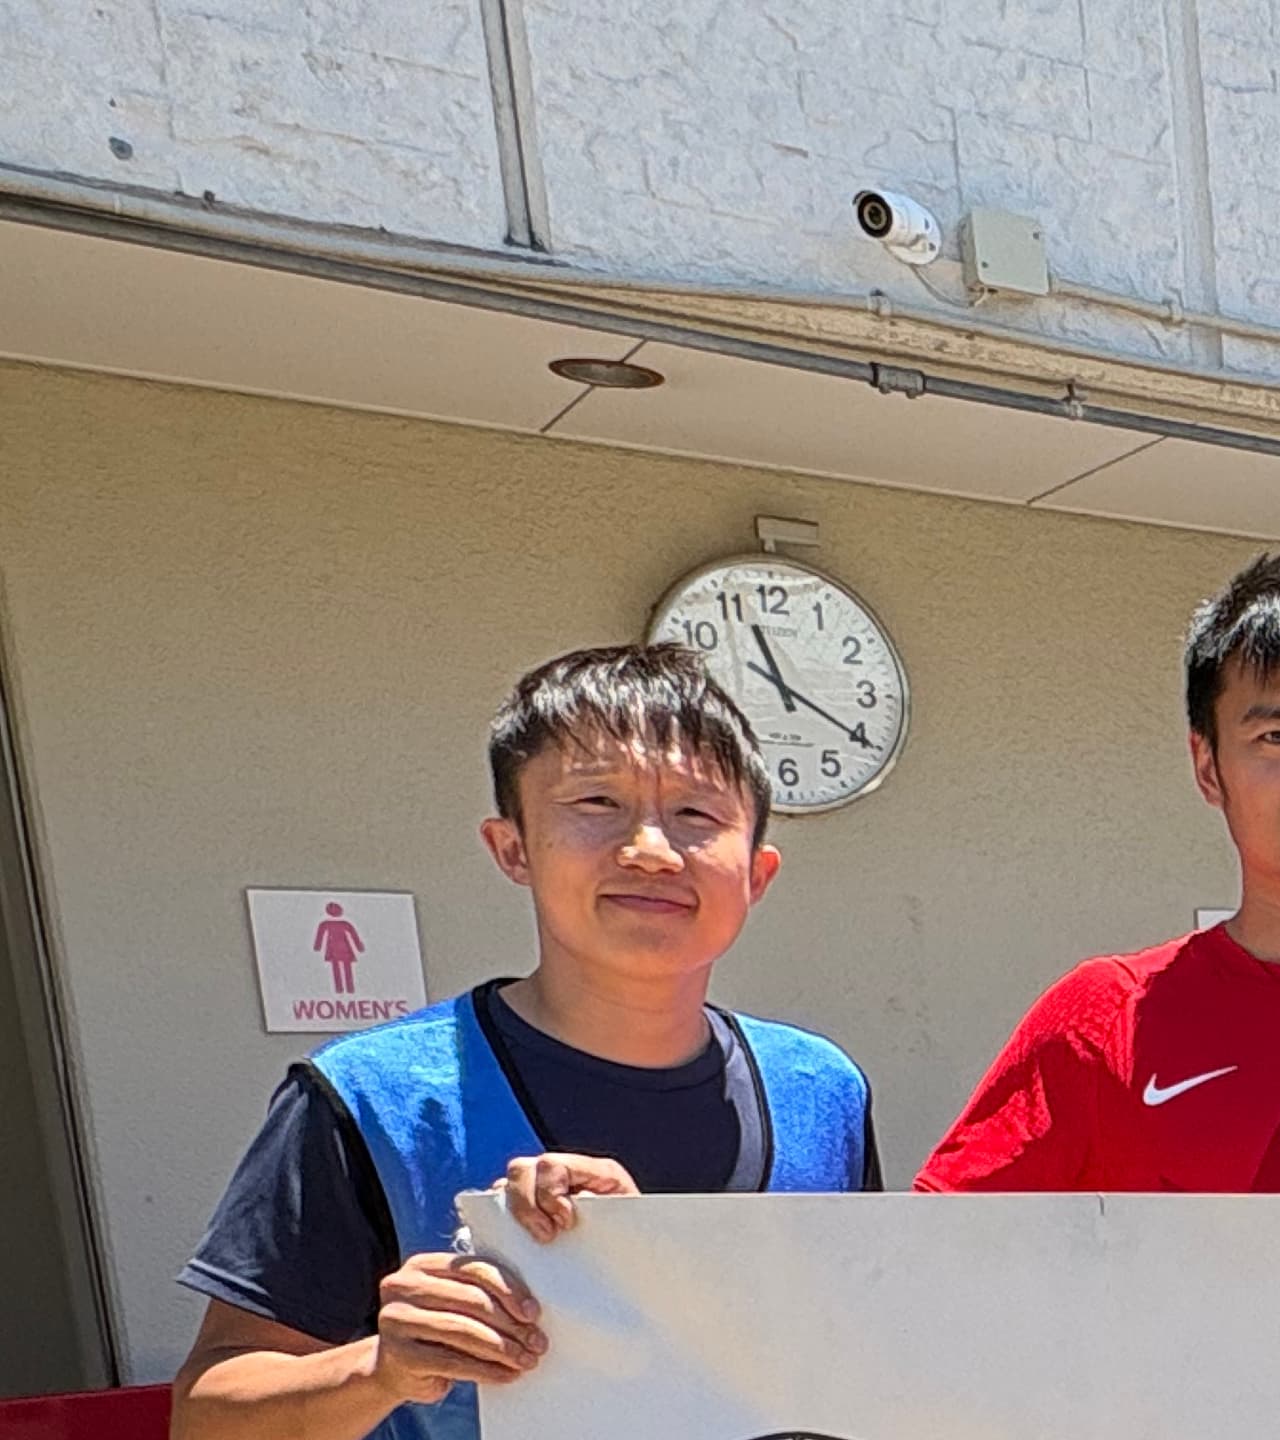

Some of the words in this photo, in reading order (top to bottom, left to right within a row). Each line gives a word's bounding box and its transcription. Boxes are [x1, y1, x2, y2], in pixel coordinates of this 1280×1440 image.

[716, 591, 744, 622] 11
[756, 584, 790, 616] 12
[812, 601, 825, 631] 1
[682, 620, 718, 651] 10
[841, 636, 863, 665] 2
[856, 680, 877, 709] 3
[850, 721, 869, 749] 4
[778, 758, 800, 787] 6
[820, 749, 842, 778] 5
[293, 1000, 409, 1020] WOMEN'S
